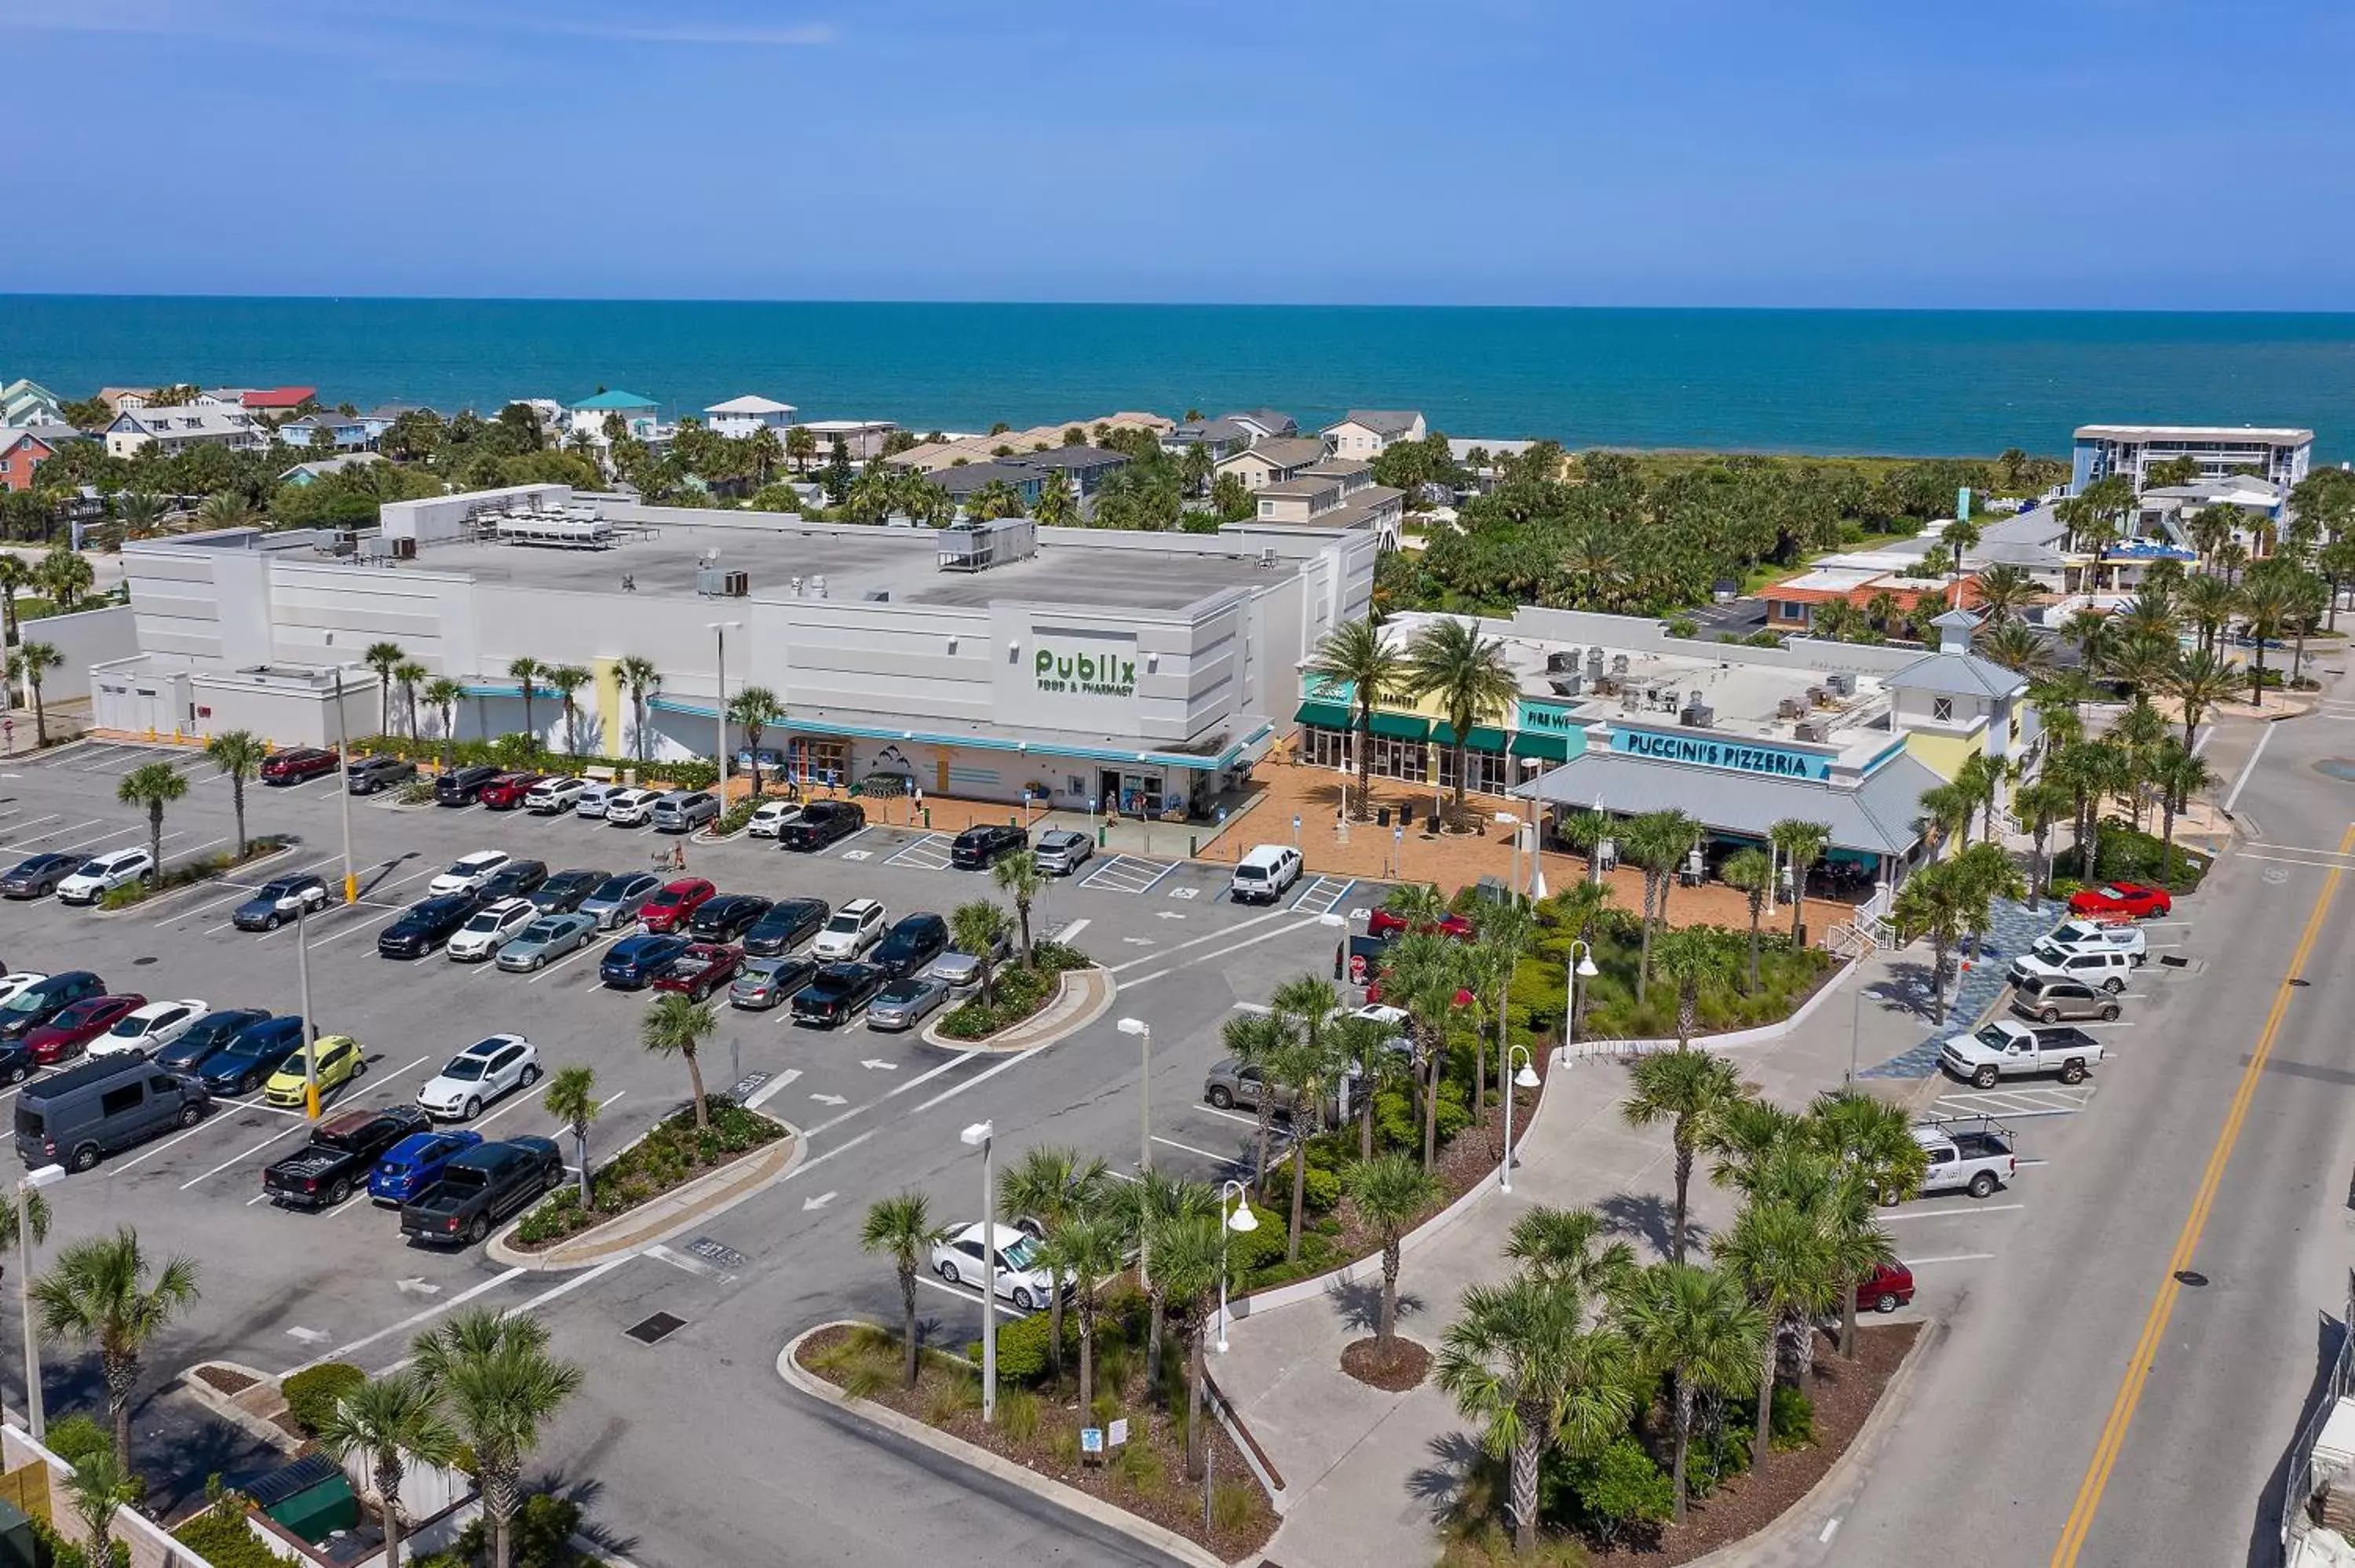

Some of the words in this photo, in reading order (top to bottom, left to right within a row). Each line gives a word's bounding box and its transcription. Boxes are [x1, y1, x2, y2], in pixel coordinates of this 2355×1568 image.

[1035, 650, 1135, 684] Publix
[1038, 680, 1065, 691] FOOD
[1083, 682, 1134, 697] PHARMACY
[1527, 711, 1550, 727] FIRE
[1628, 734, 1718, 764] PUCCINI'S
[1723, 746, 1807, 777] PIZZERIA
